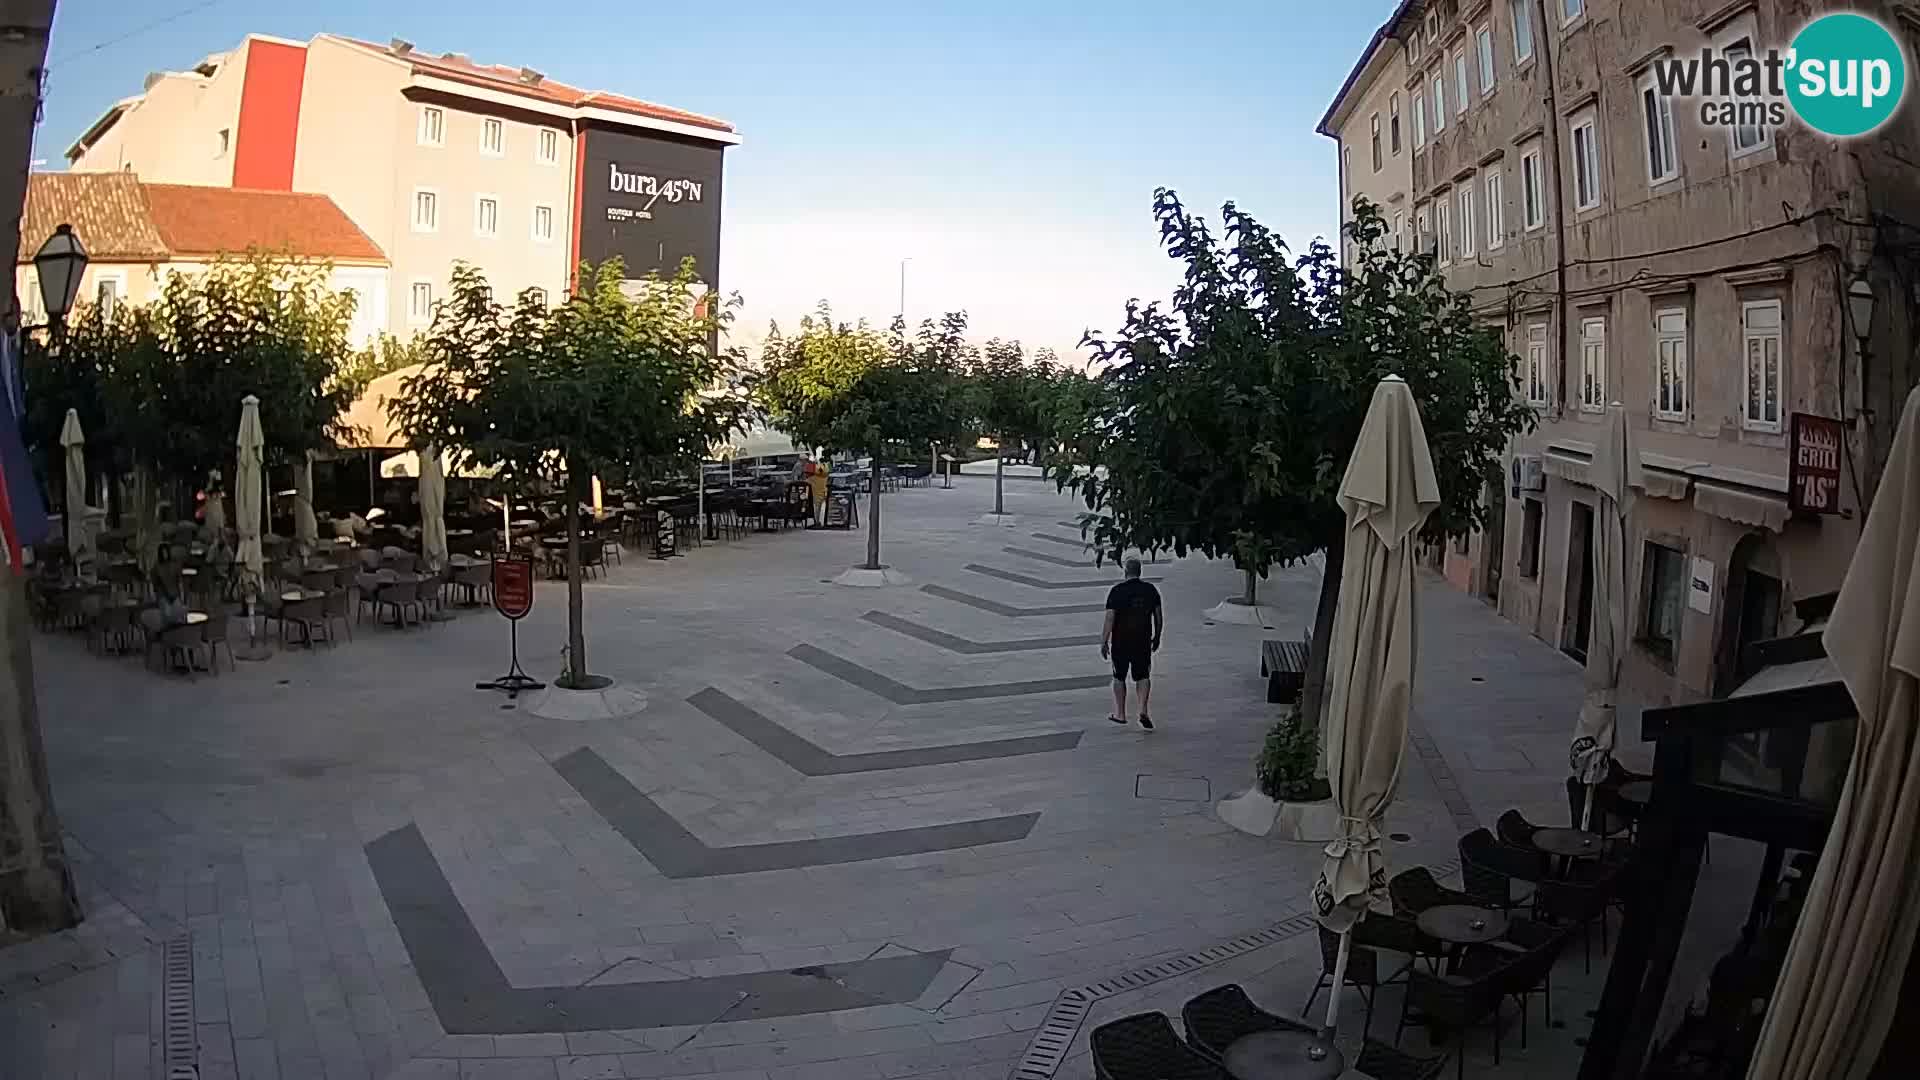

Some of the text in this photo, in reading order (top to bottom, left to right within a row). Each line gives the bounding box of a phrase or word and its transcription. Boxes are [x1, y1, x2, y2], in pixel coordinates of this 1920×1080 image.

[610, 164, 657, 196] bura
[635, 211, 652, 219] HOTEL
[1798, 446, 1837, 470] GRILL
